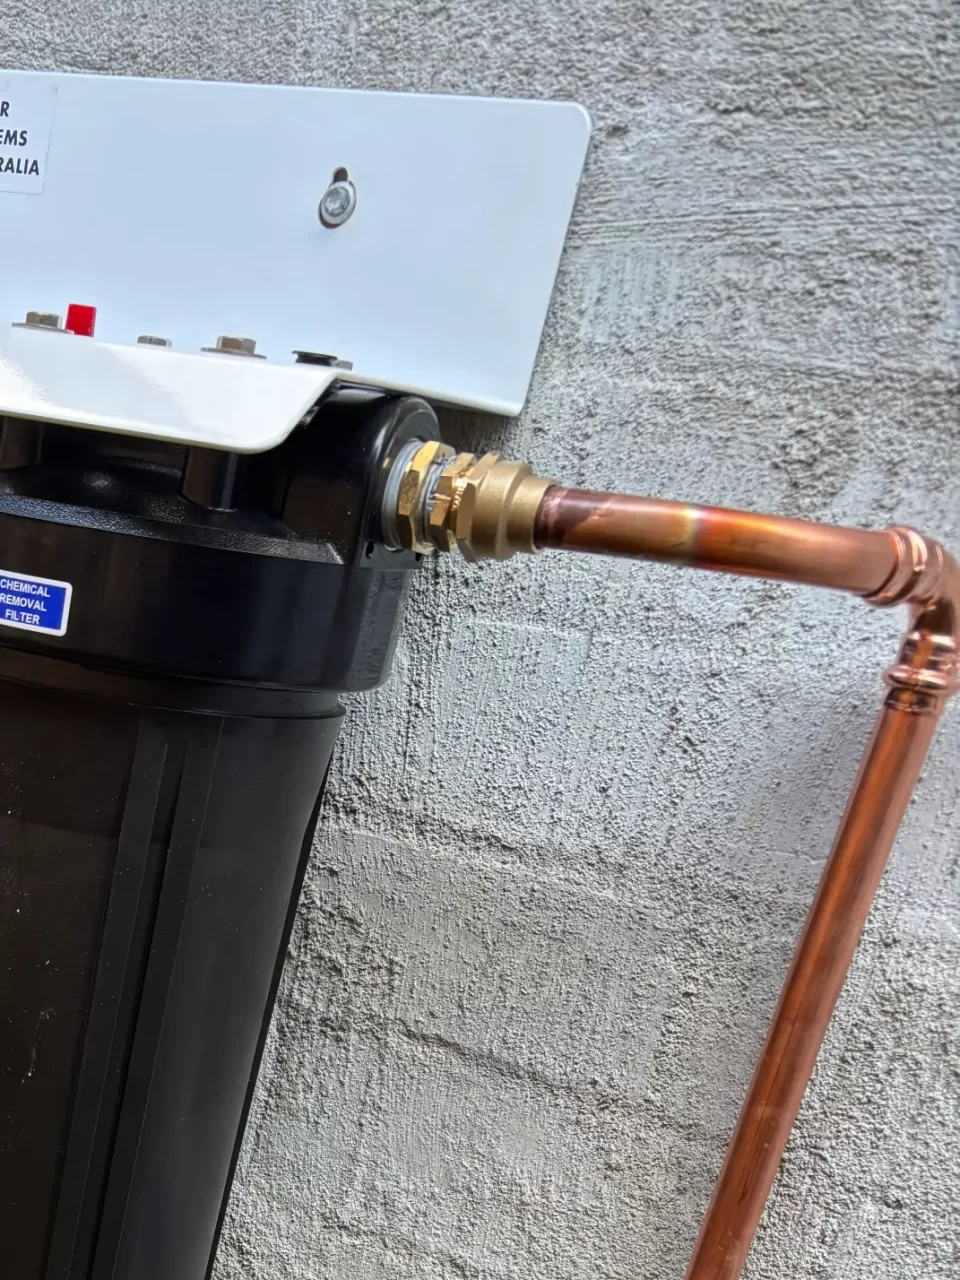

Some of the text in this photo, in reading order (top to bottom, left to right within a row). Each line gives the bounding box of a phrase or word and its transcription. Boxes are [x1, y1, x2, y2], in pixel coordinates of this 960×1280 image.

[0, 579, 51, 598] CHEMICAL
[0, 592, 48, 612] REMOVAL
[5, 608, 40, 625] FILTER
